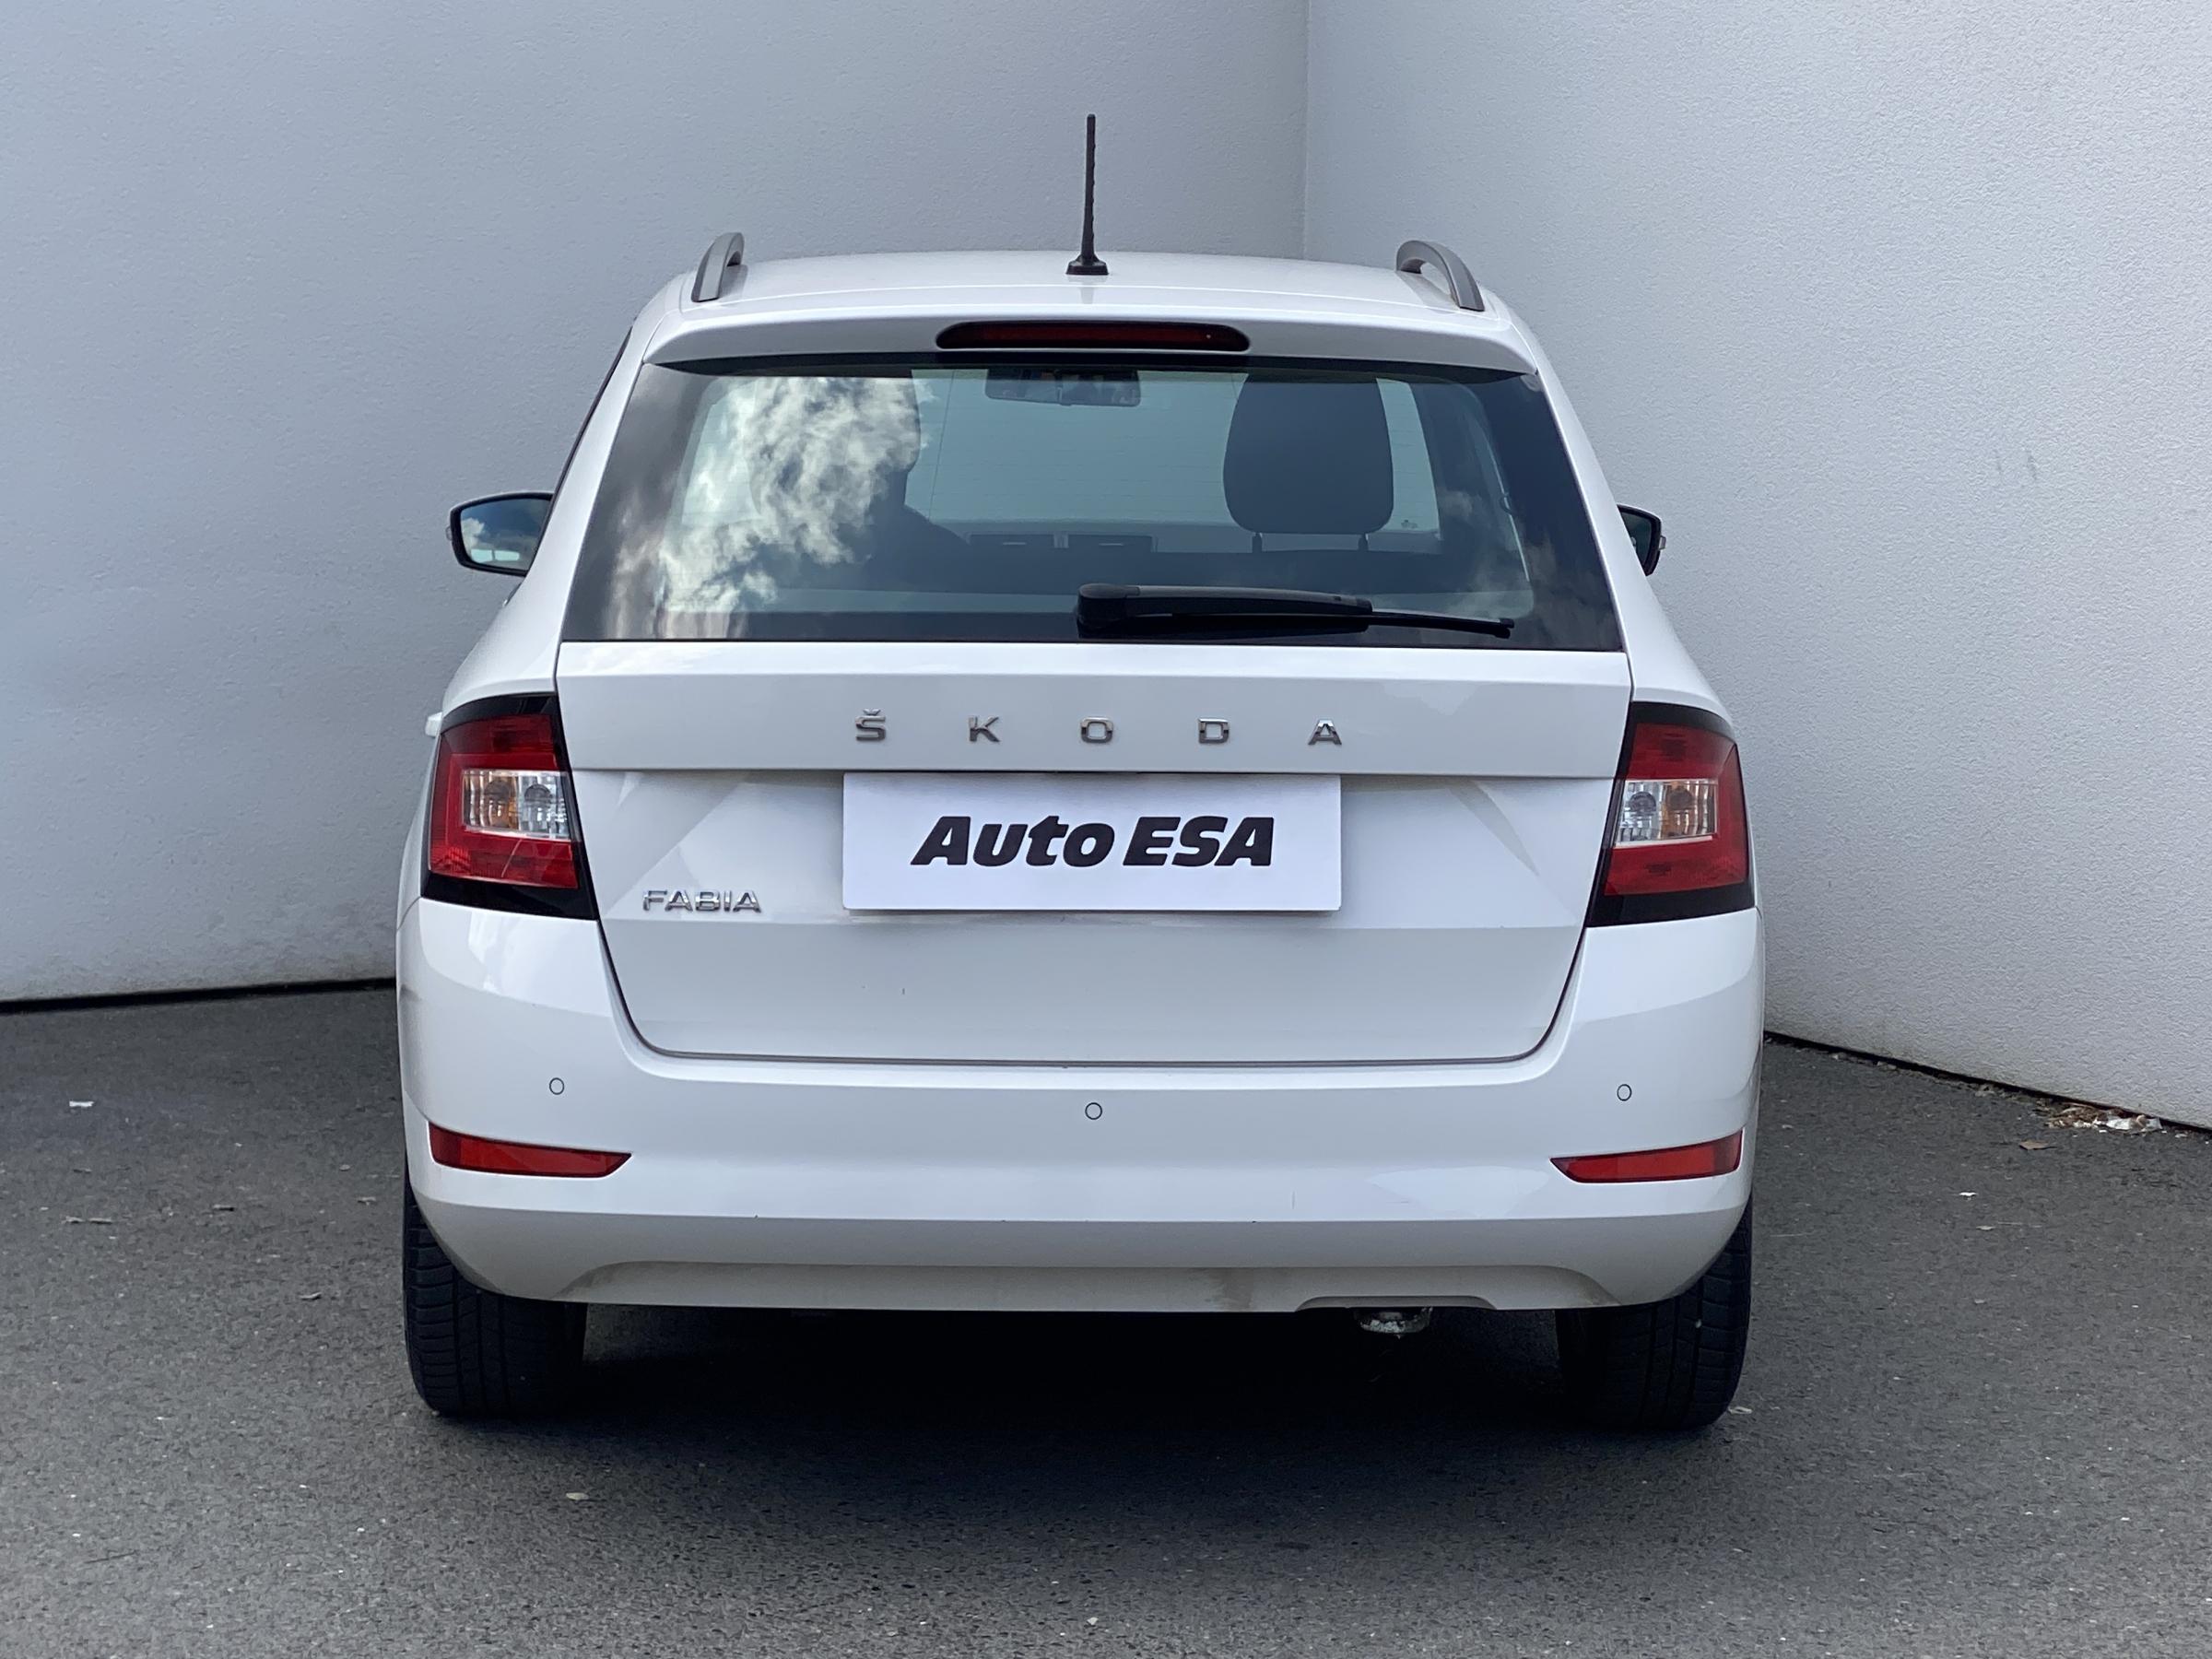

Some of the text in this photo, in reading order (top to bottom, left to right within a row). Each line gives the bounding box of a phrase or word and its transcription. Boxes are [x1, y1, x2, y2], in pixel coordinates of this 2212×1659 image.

[855, 708, 1343, 746] ŠKODA
[910, 815, 1275, 866] Auto ESA
[642, 889, 762, 913] FABIA
